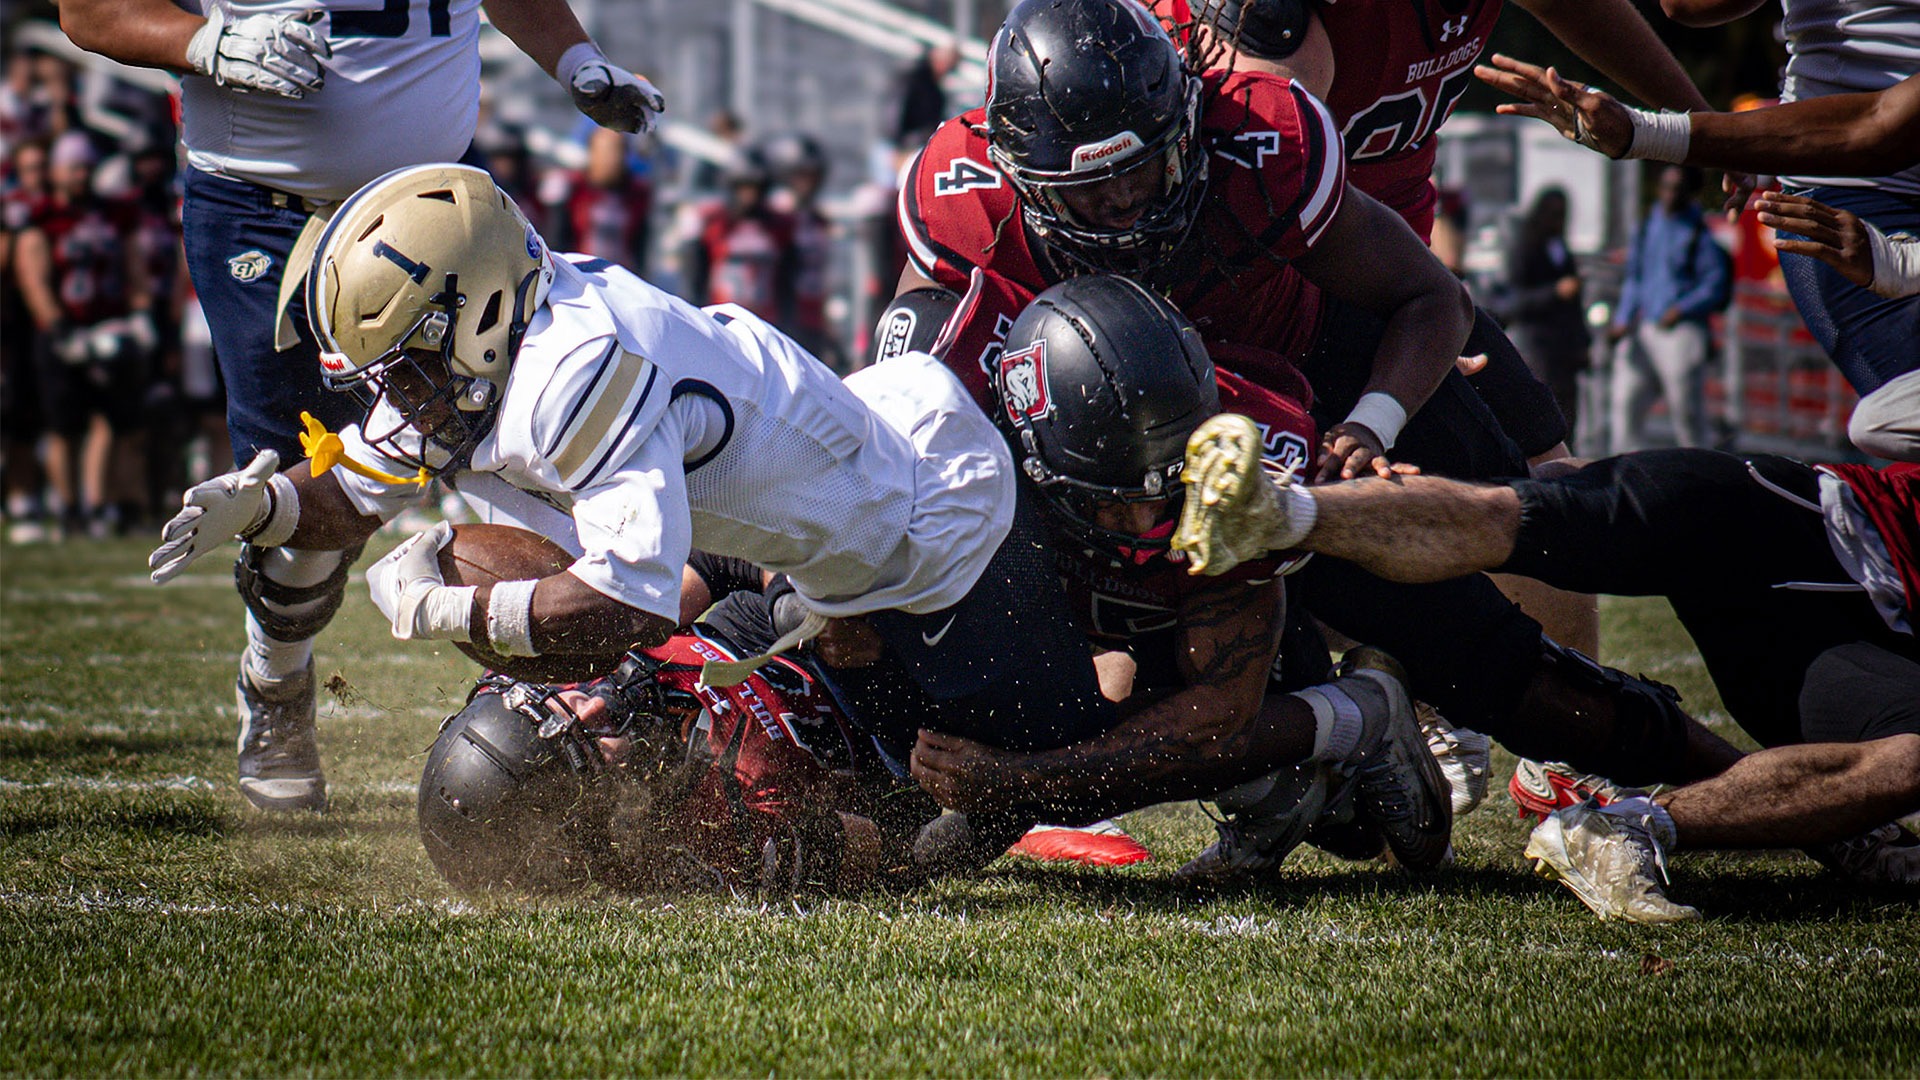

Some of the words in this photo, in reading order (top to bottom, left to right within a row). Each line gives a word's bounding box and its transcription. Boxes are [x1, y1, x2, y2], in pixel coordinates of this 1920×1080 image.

[1405, 36, 1480, 84] BULLDOGS
[1080, 138, 1132, 163] Riddell
[934, 157, 1001, 197] 4
[373, 240, 431, 286] 1
[1167, 460, 1185, 477] F7
[1255, 422, 1309, 482] 5
[689, 641, 784, 741] BULLGS
